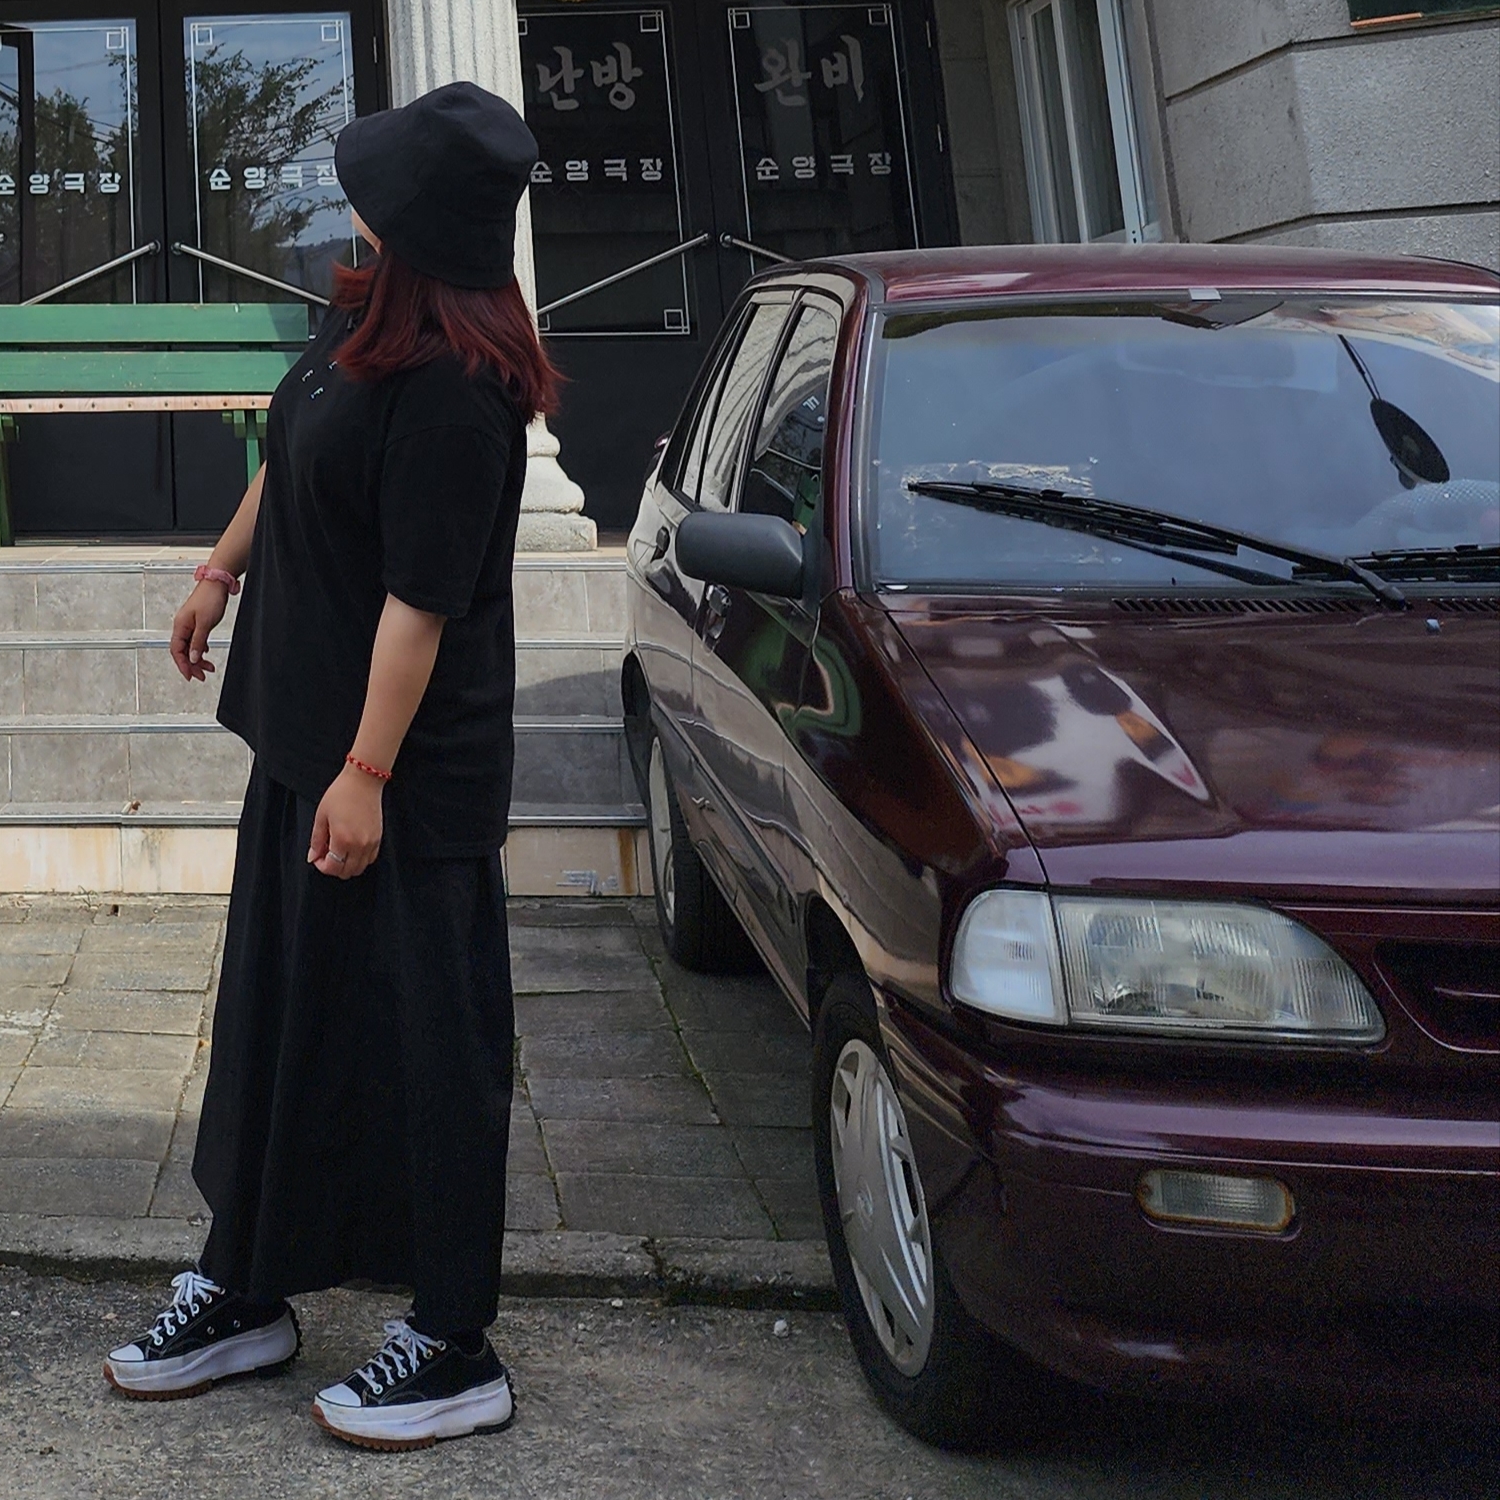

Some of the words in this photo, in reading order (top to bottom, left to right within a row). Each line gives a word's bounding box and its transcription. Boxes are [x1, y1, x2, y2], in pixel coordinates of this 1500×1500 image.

[536, 41, 644, 111] 난방
[754, 33, 865, 108] 완비
[208, 164, 338, 192] 순양극장
[755, 152, 893, 182] 순양극장
